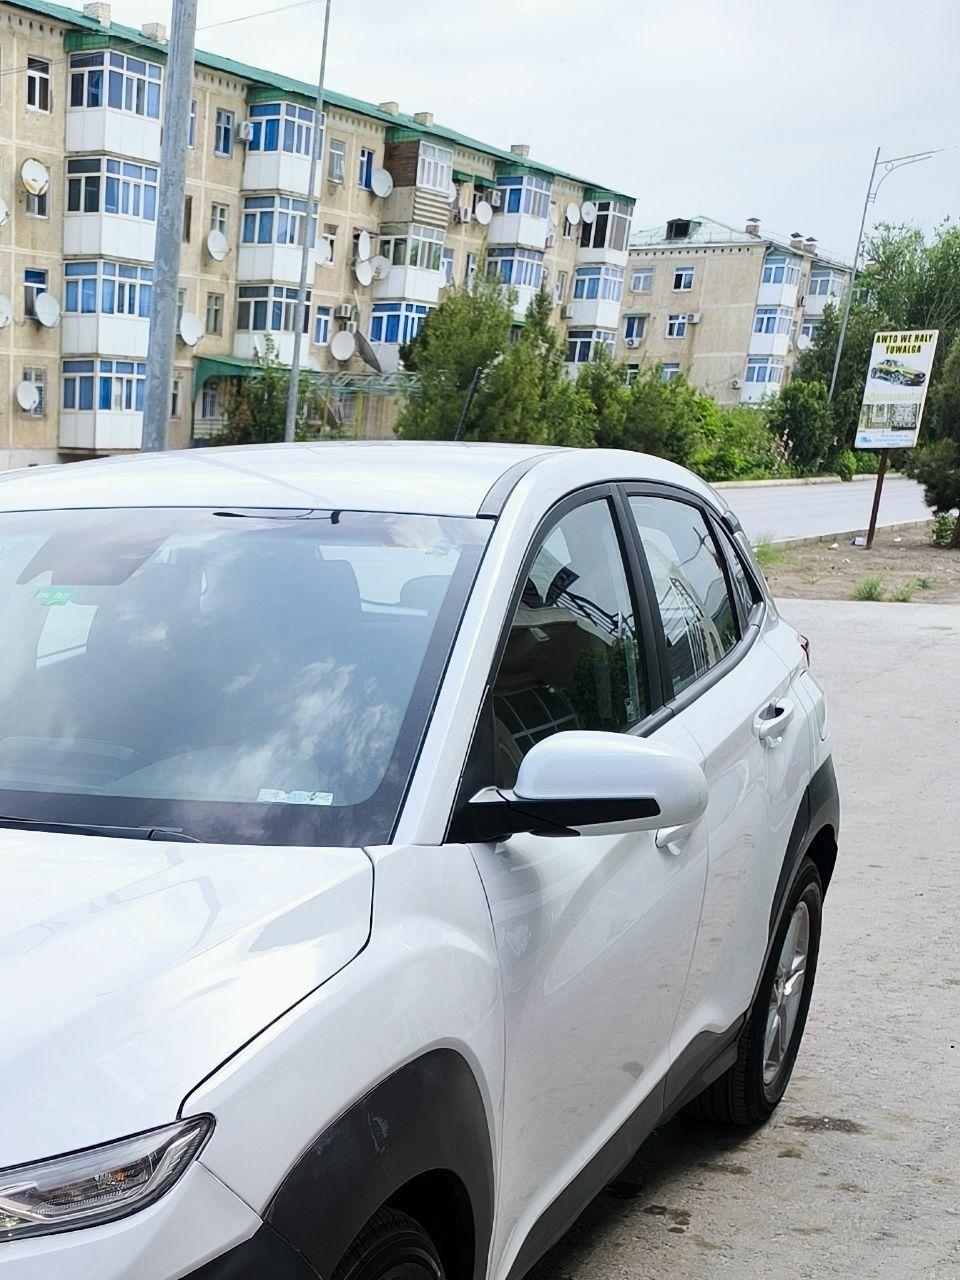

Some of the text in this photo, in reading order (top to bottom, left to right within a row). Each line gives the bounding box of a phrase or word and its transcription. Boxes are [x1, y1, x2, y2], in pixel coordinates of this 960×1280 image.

[876, 333, 934, 343] AWTO WE HALY
